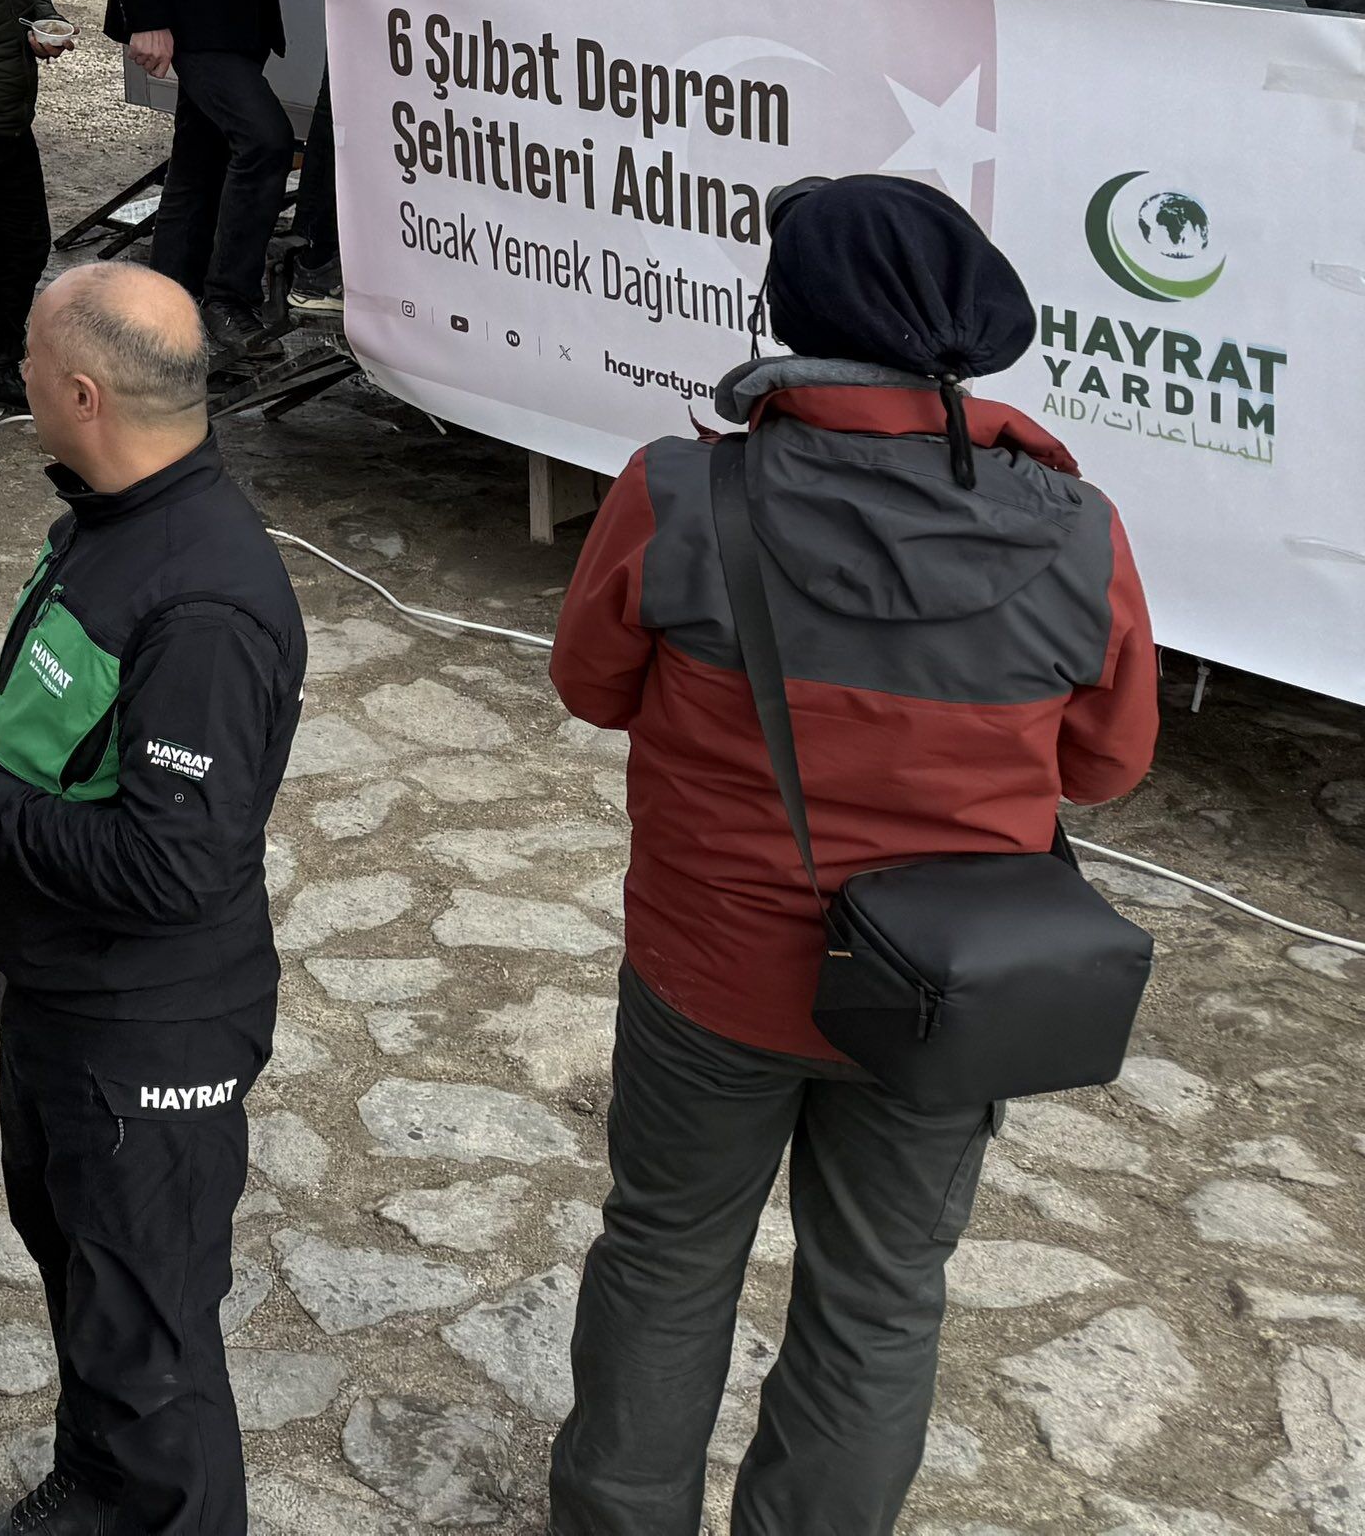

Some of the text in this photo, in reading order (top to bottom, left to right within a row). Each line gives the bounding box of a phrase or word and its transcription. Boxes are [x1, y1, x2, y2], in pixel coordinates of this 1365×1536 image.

[387, 7, 789, 147] 6 Şubat Deprem
[392, 100, 761, 246] Şehitleri Adına
[400, 201, 478, 267] Sıcak
[485, 220, 592, 295] Yemek
[1041, 304, 1287, 395] HAYRAT
[1042, 355, 1275, 436] YARDIM
[30, 639, 74, 690] HAYRAT
[146, 740, 214, 772] HAYRAT
[140, 1078, 238, 1110] HAYRAT
